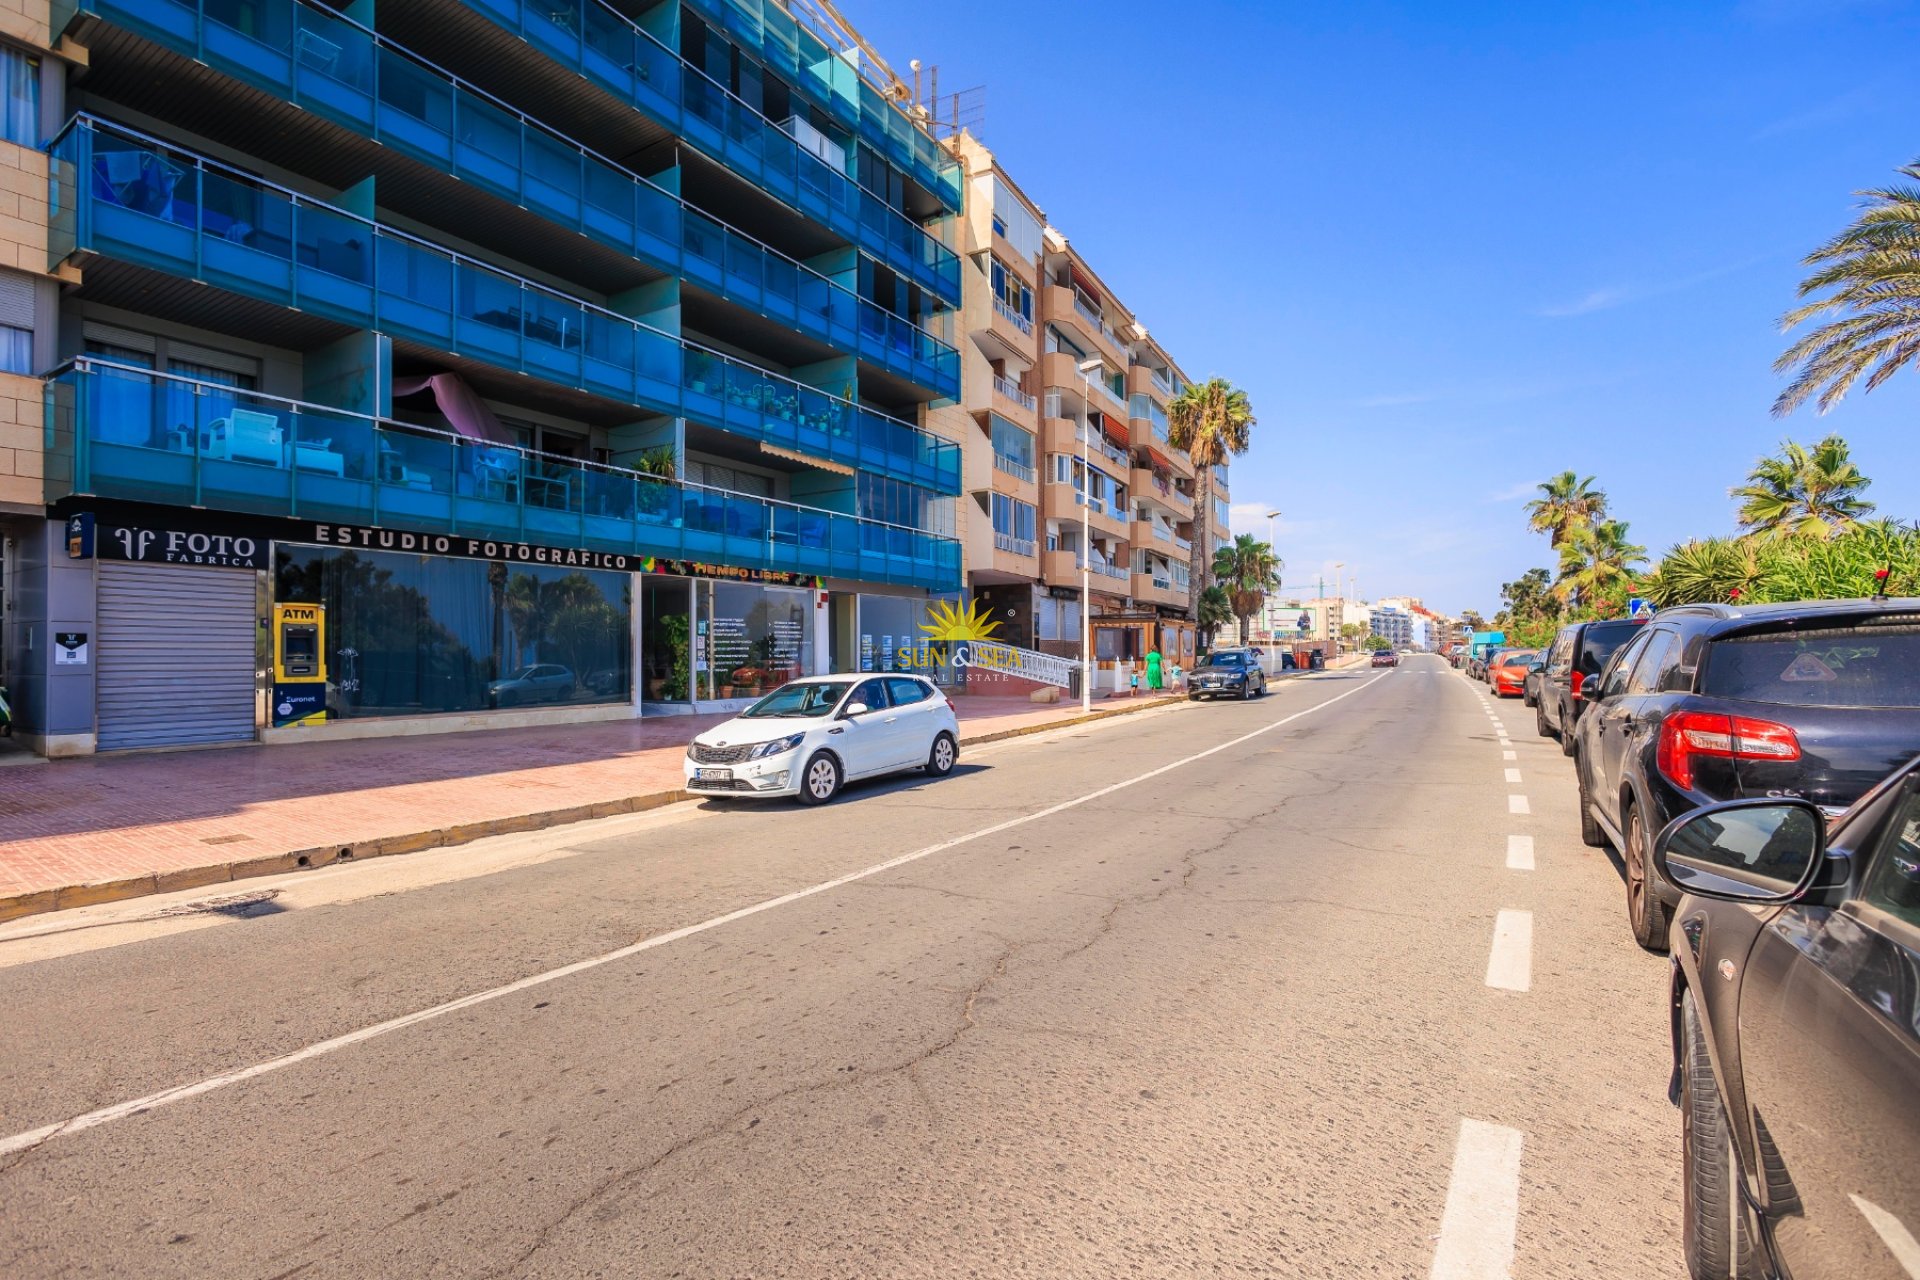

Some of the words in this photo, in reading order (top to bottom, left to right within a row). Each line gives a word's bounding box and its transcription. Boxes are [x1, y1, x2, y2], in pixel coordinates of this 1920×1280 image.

[165, 530, 256, 557] FOTO
[316, 524, 450, 552] ESTUDIO
[468, 540, 627, 569] FOTOGRÁFICO
[166, 552, 254, 567] FABRICA
[692, 562, 749, 578] TIEMPO
[751, 570, 790, 582] LIBRE
[283, 609, 314, 619] ATM
